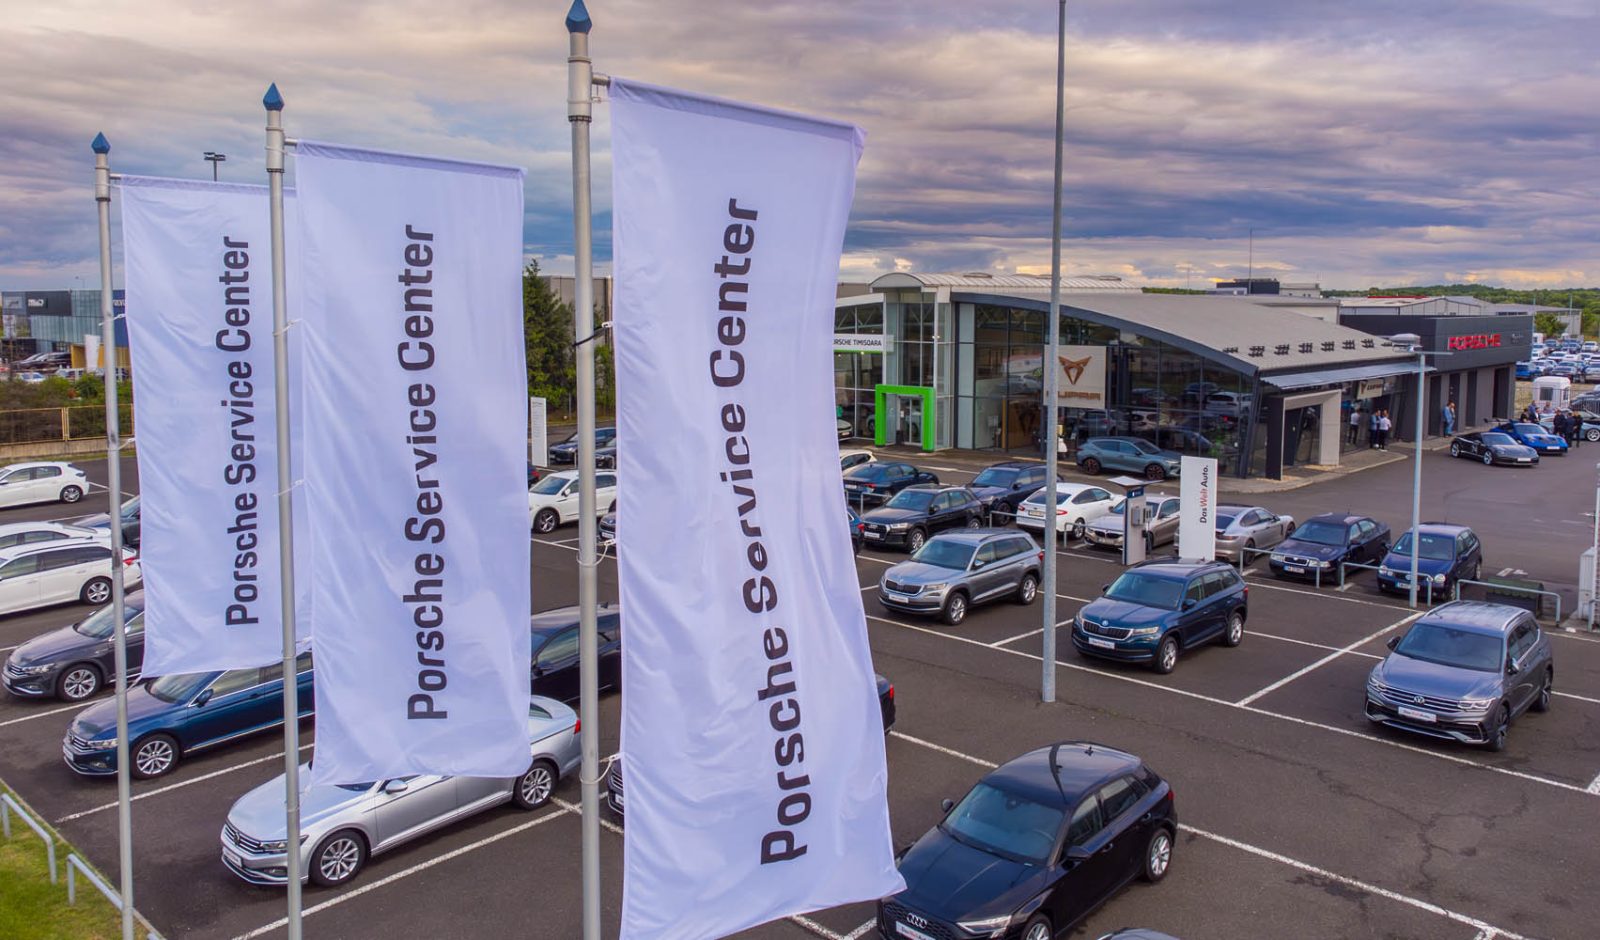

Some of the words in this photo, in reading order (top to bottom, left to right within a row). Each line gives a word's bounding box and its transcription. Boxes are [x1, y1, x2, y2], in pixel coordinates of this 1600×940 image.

[215, 236, 251, 353] Center
[397, 224, 434, 372] Center
[709, 197, 759, 388] Center
[1447, 334, 1501, 351] PORSCHE
[220, 361, 257, 486] Service
[404, 383, 446, 545] Service
[1200, 465, 1209, 488] Auto.
[225, 492, 259, 626] Porsche
[719, 403, 778, 614] Service
[1199, 507, 1208, 524] Das
[402, 553, 448, 720] Porsche
[757, 626, 812, 866] Porsche
